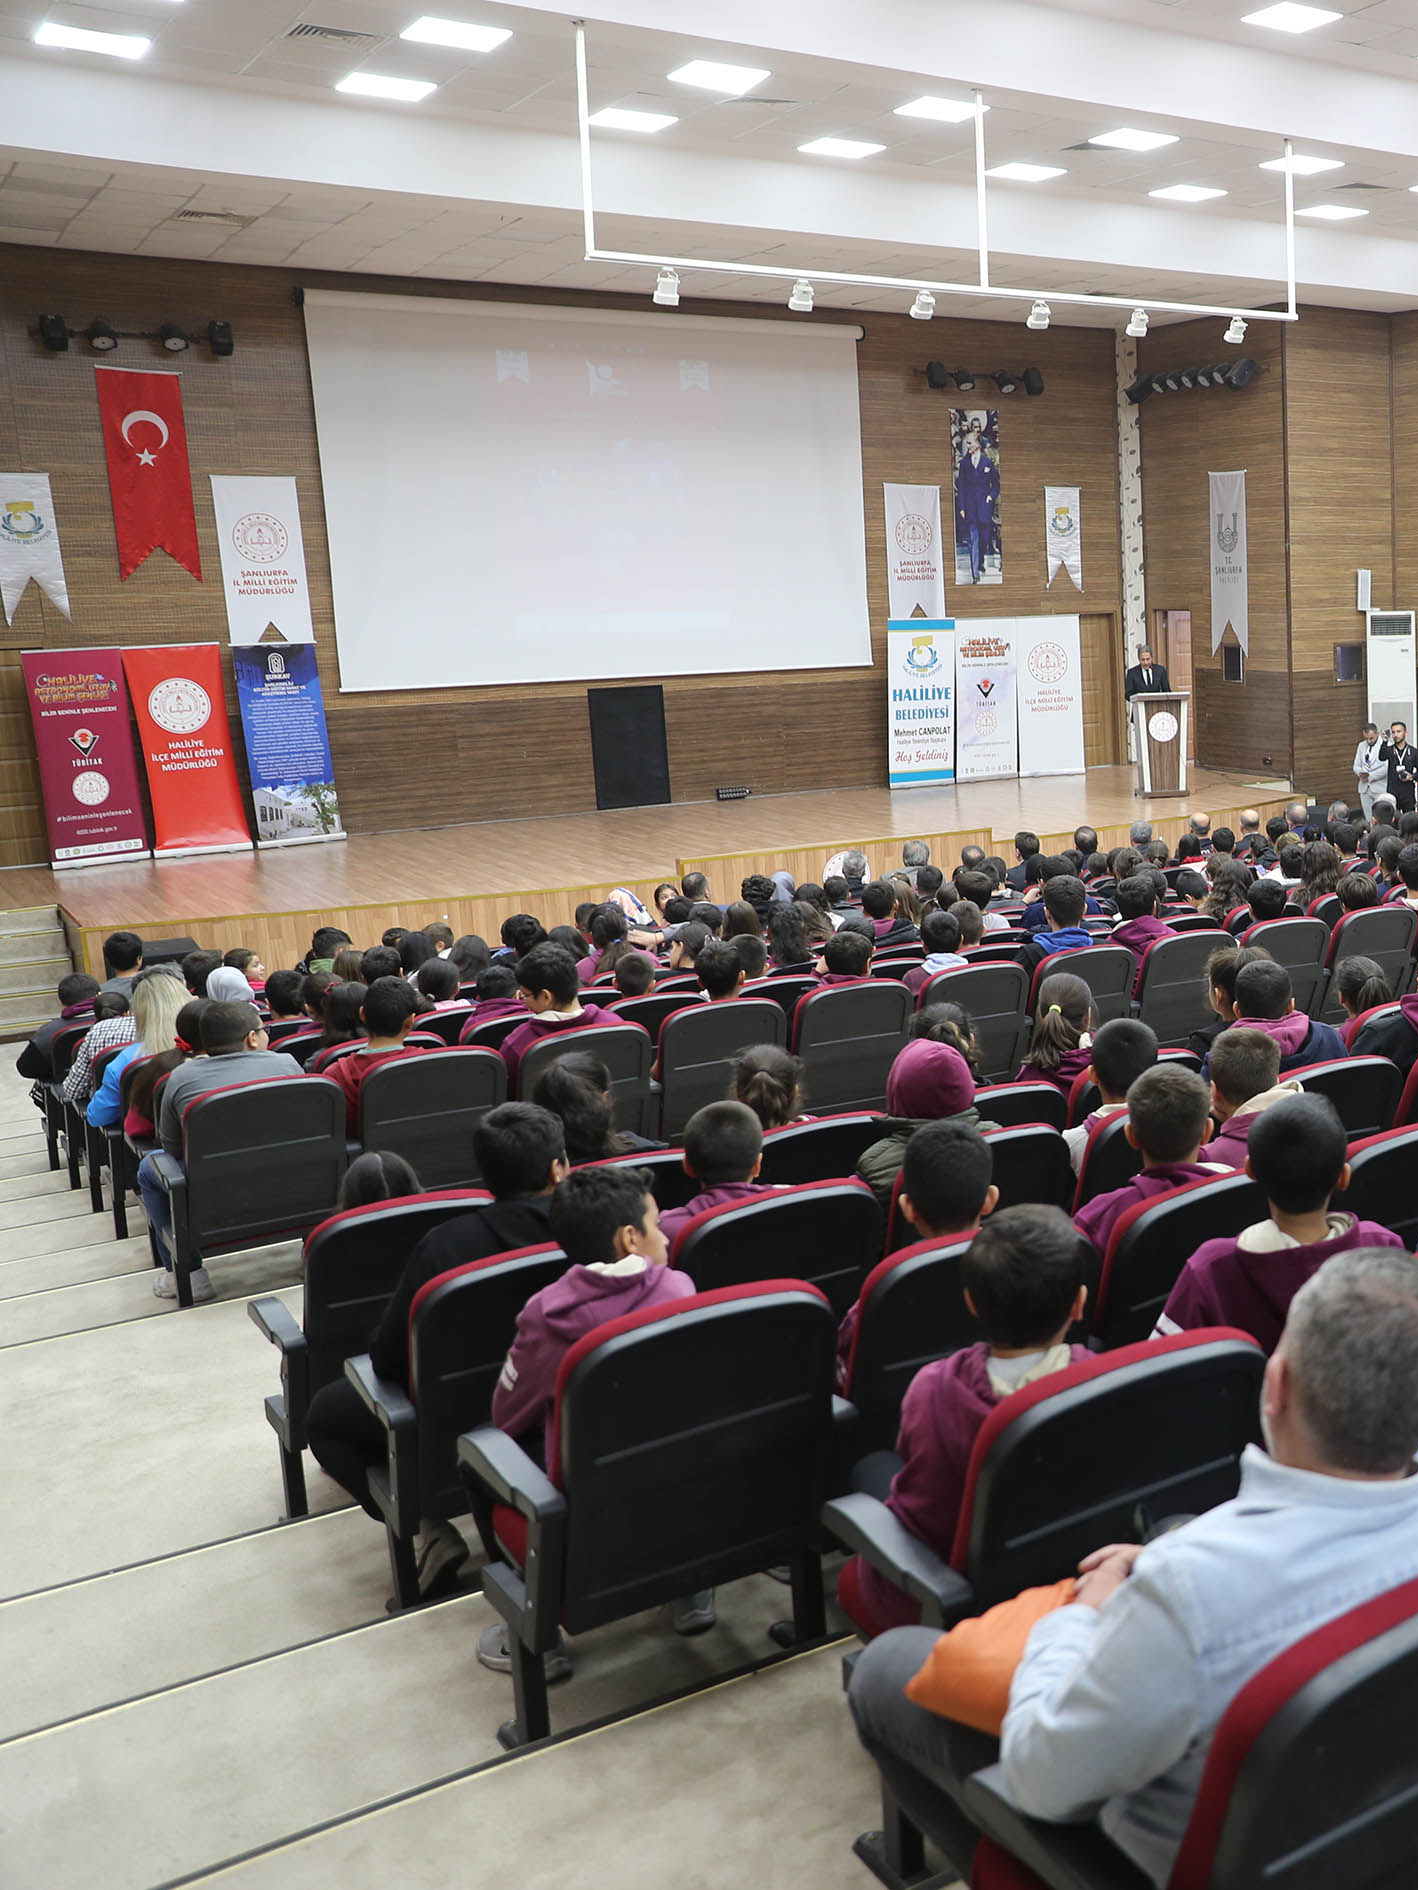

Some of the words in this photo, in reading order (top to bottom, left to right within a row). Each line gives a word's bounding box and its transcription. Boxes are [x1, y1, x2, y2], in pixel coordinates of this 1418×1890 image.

[240, 570, 288, 578] ŞANLIURFA
[238, 587, 295, 595] MÜDÜRLÜĞÜ
[893, 684, 952, 702] HALİLİYE
[895, 705, 949, 720] BELEDİYESİ
[894, 728, 918, 737] Mehmet
[919, 726, 951, 736] CANPOLAT
[168, 739, 204, 749] HALİLİYE
[151, 752, 169, 763] İLÇE
[170, 750, 193, 760] MİLLİ
[194, 747, 224, 758] EĞİTİM
[896, 751, 912, 763] Hoş
[914, 749, 949, 763] Geldiniz
[72, 757, 103, 767] TÜBİTAK
[161, 759, 218, 772] MÜDÜRLÜĞÜ
